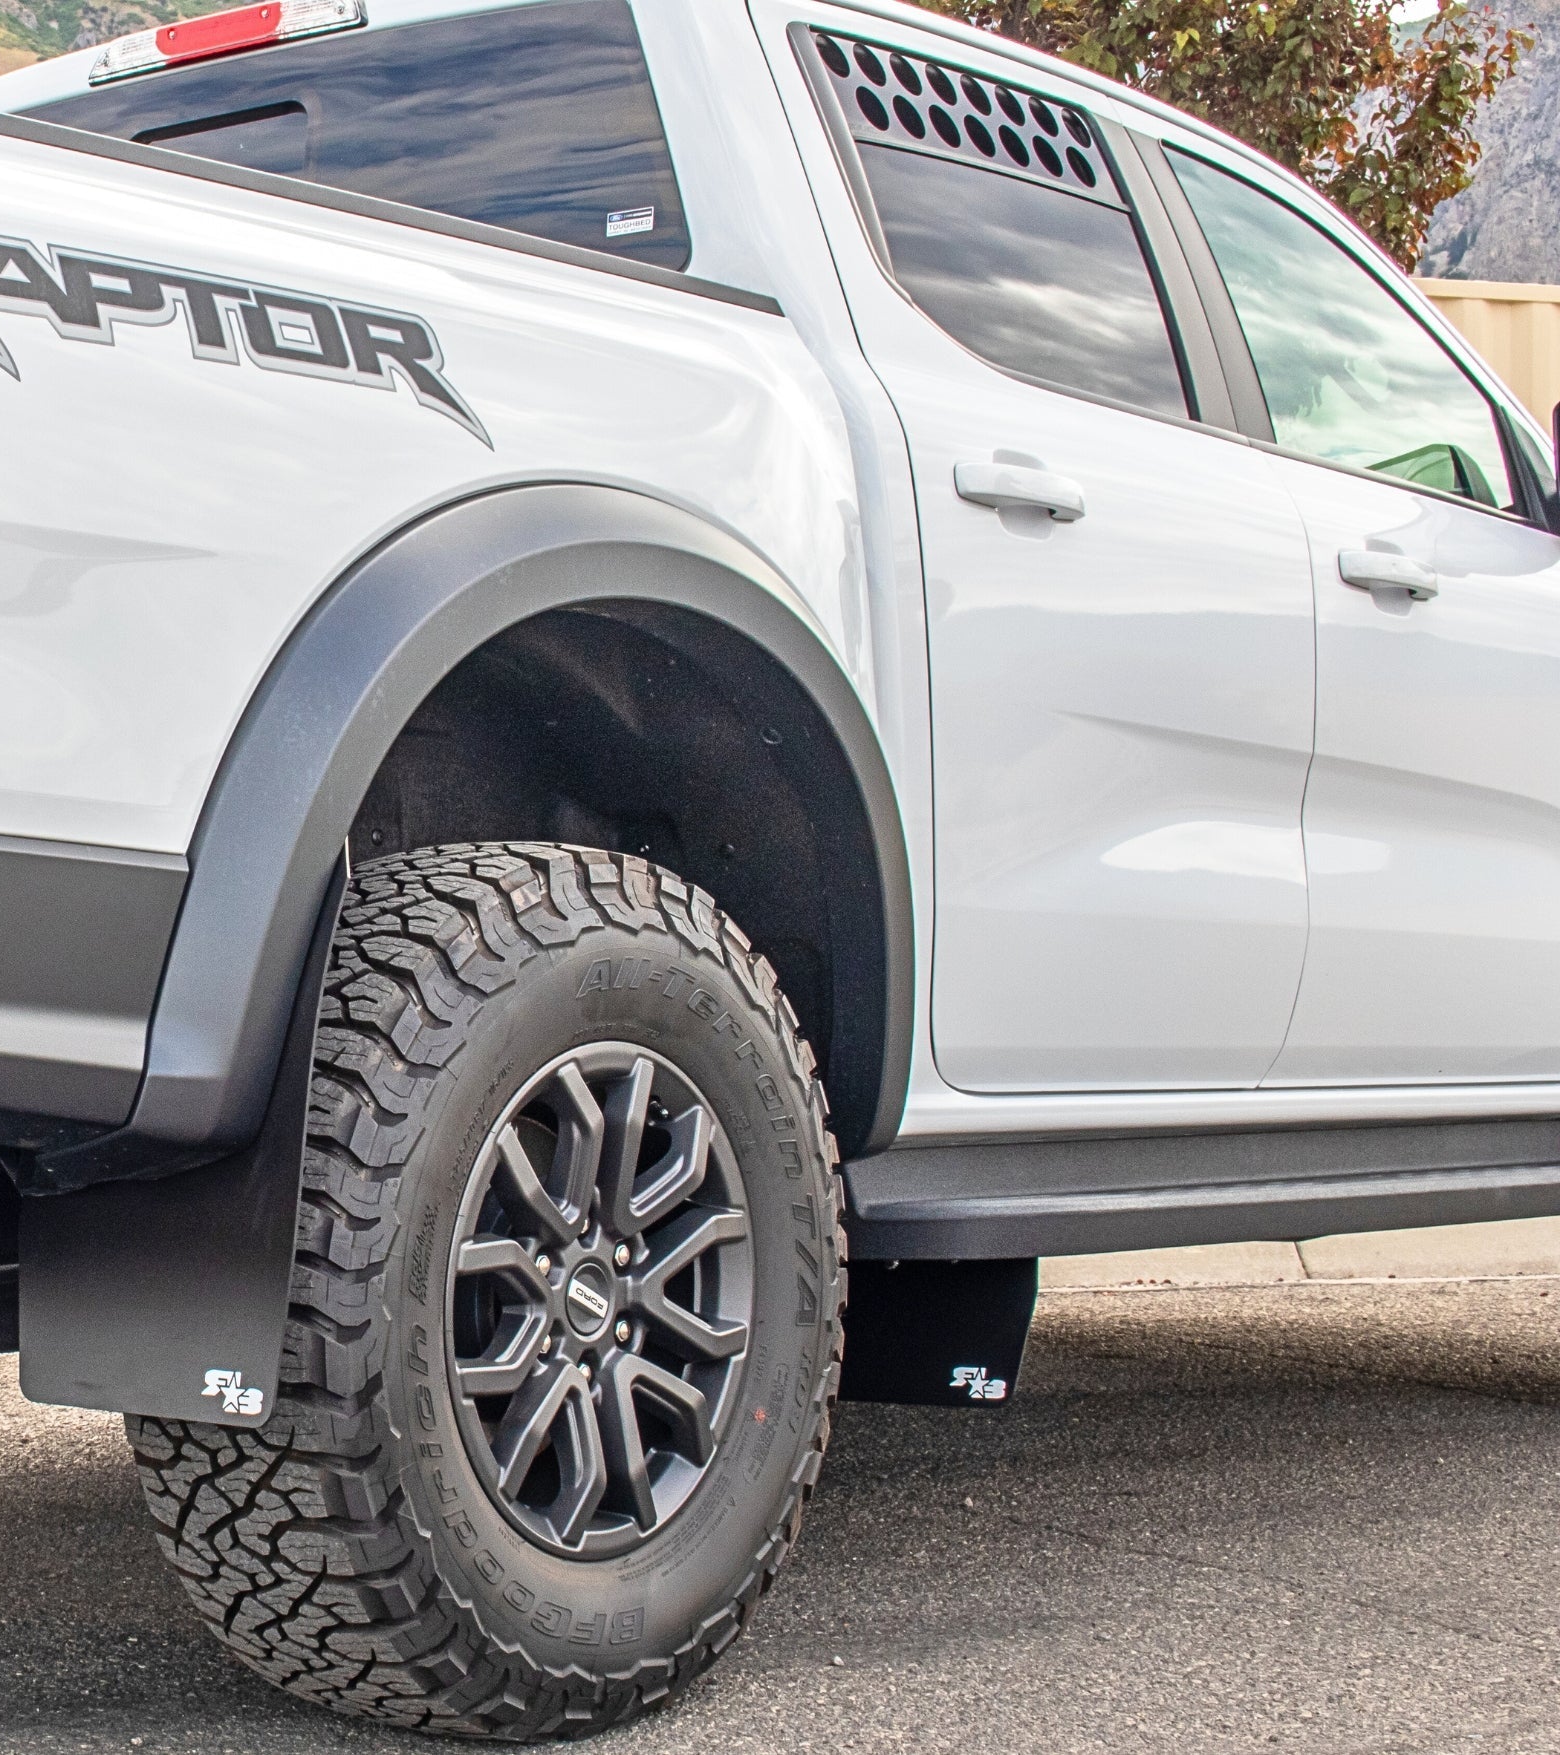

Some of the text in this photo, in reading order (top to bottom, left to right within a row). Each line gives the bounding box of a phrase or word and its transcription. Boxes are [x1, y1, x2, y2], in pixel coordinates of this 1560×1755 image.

[608, 218, 651, 231] TOUGHBED
[575, 1287, 604, 1310] FORD
[408, 1322, 646, 1648] BFGoodrich
